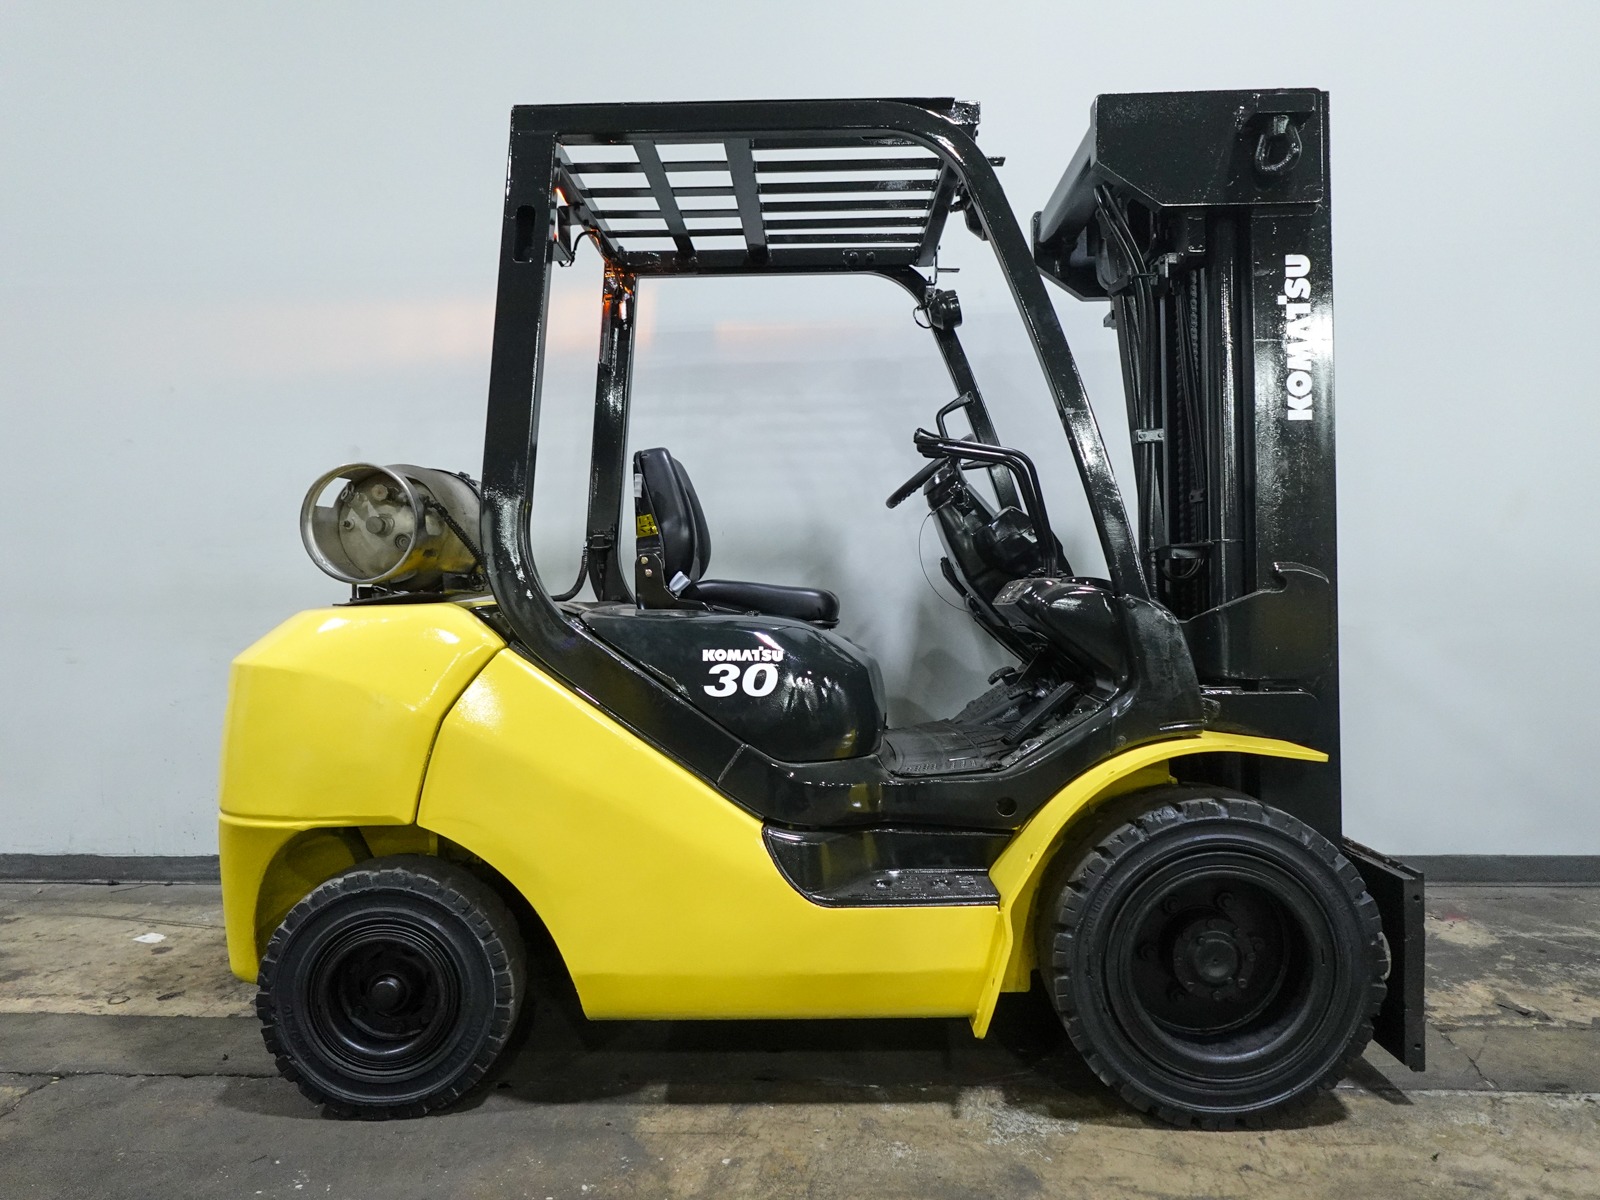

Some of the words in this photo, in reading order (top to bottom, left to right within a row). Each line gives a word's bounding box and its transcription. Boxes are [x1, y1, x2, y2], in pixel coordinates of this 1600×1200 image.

[1277, 254, 1312, 421] KOMATSU
[702, 646, 784, 662] KOMATSU
[703, 663, 779, 697] 30
